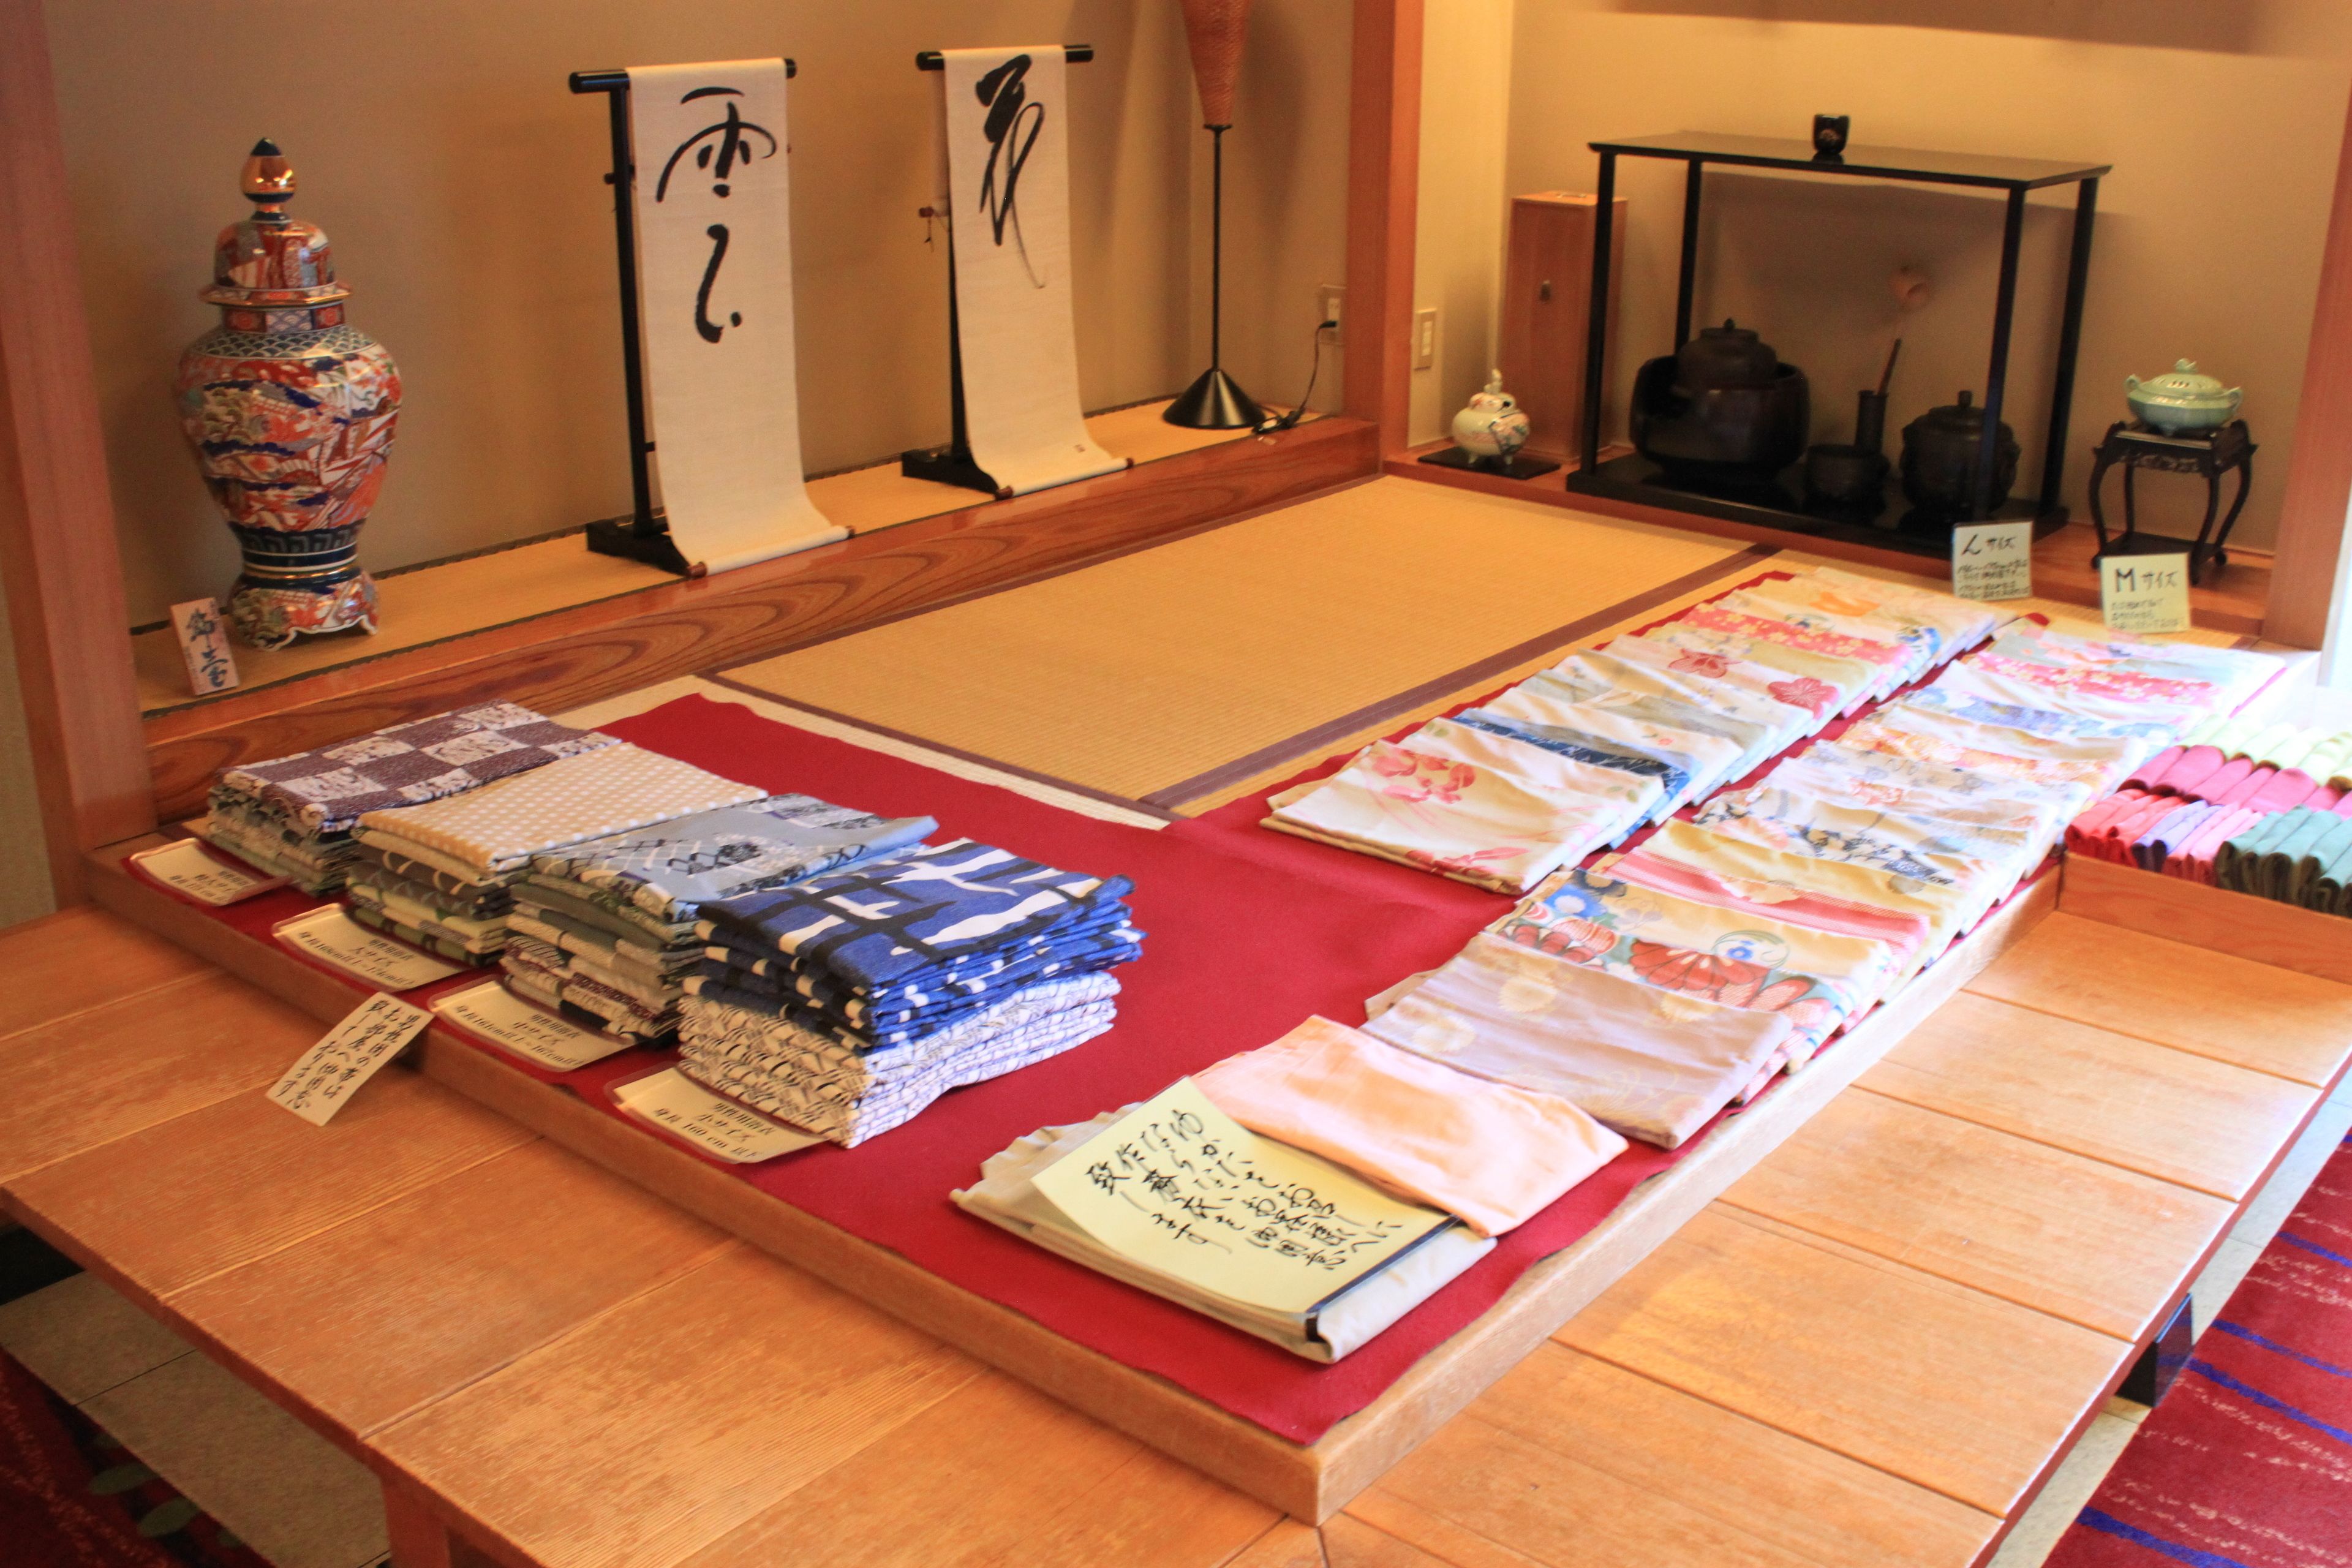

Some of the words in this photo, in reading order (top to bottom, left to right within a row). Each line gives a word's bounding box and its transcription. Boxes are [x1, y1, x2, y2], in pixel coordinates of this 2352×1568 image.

[2114, 567, 2136, 593] M
[2139, 568, 2179, 592] サイズ
[695, 1114, 755, 1143] 小サイズ
